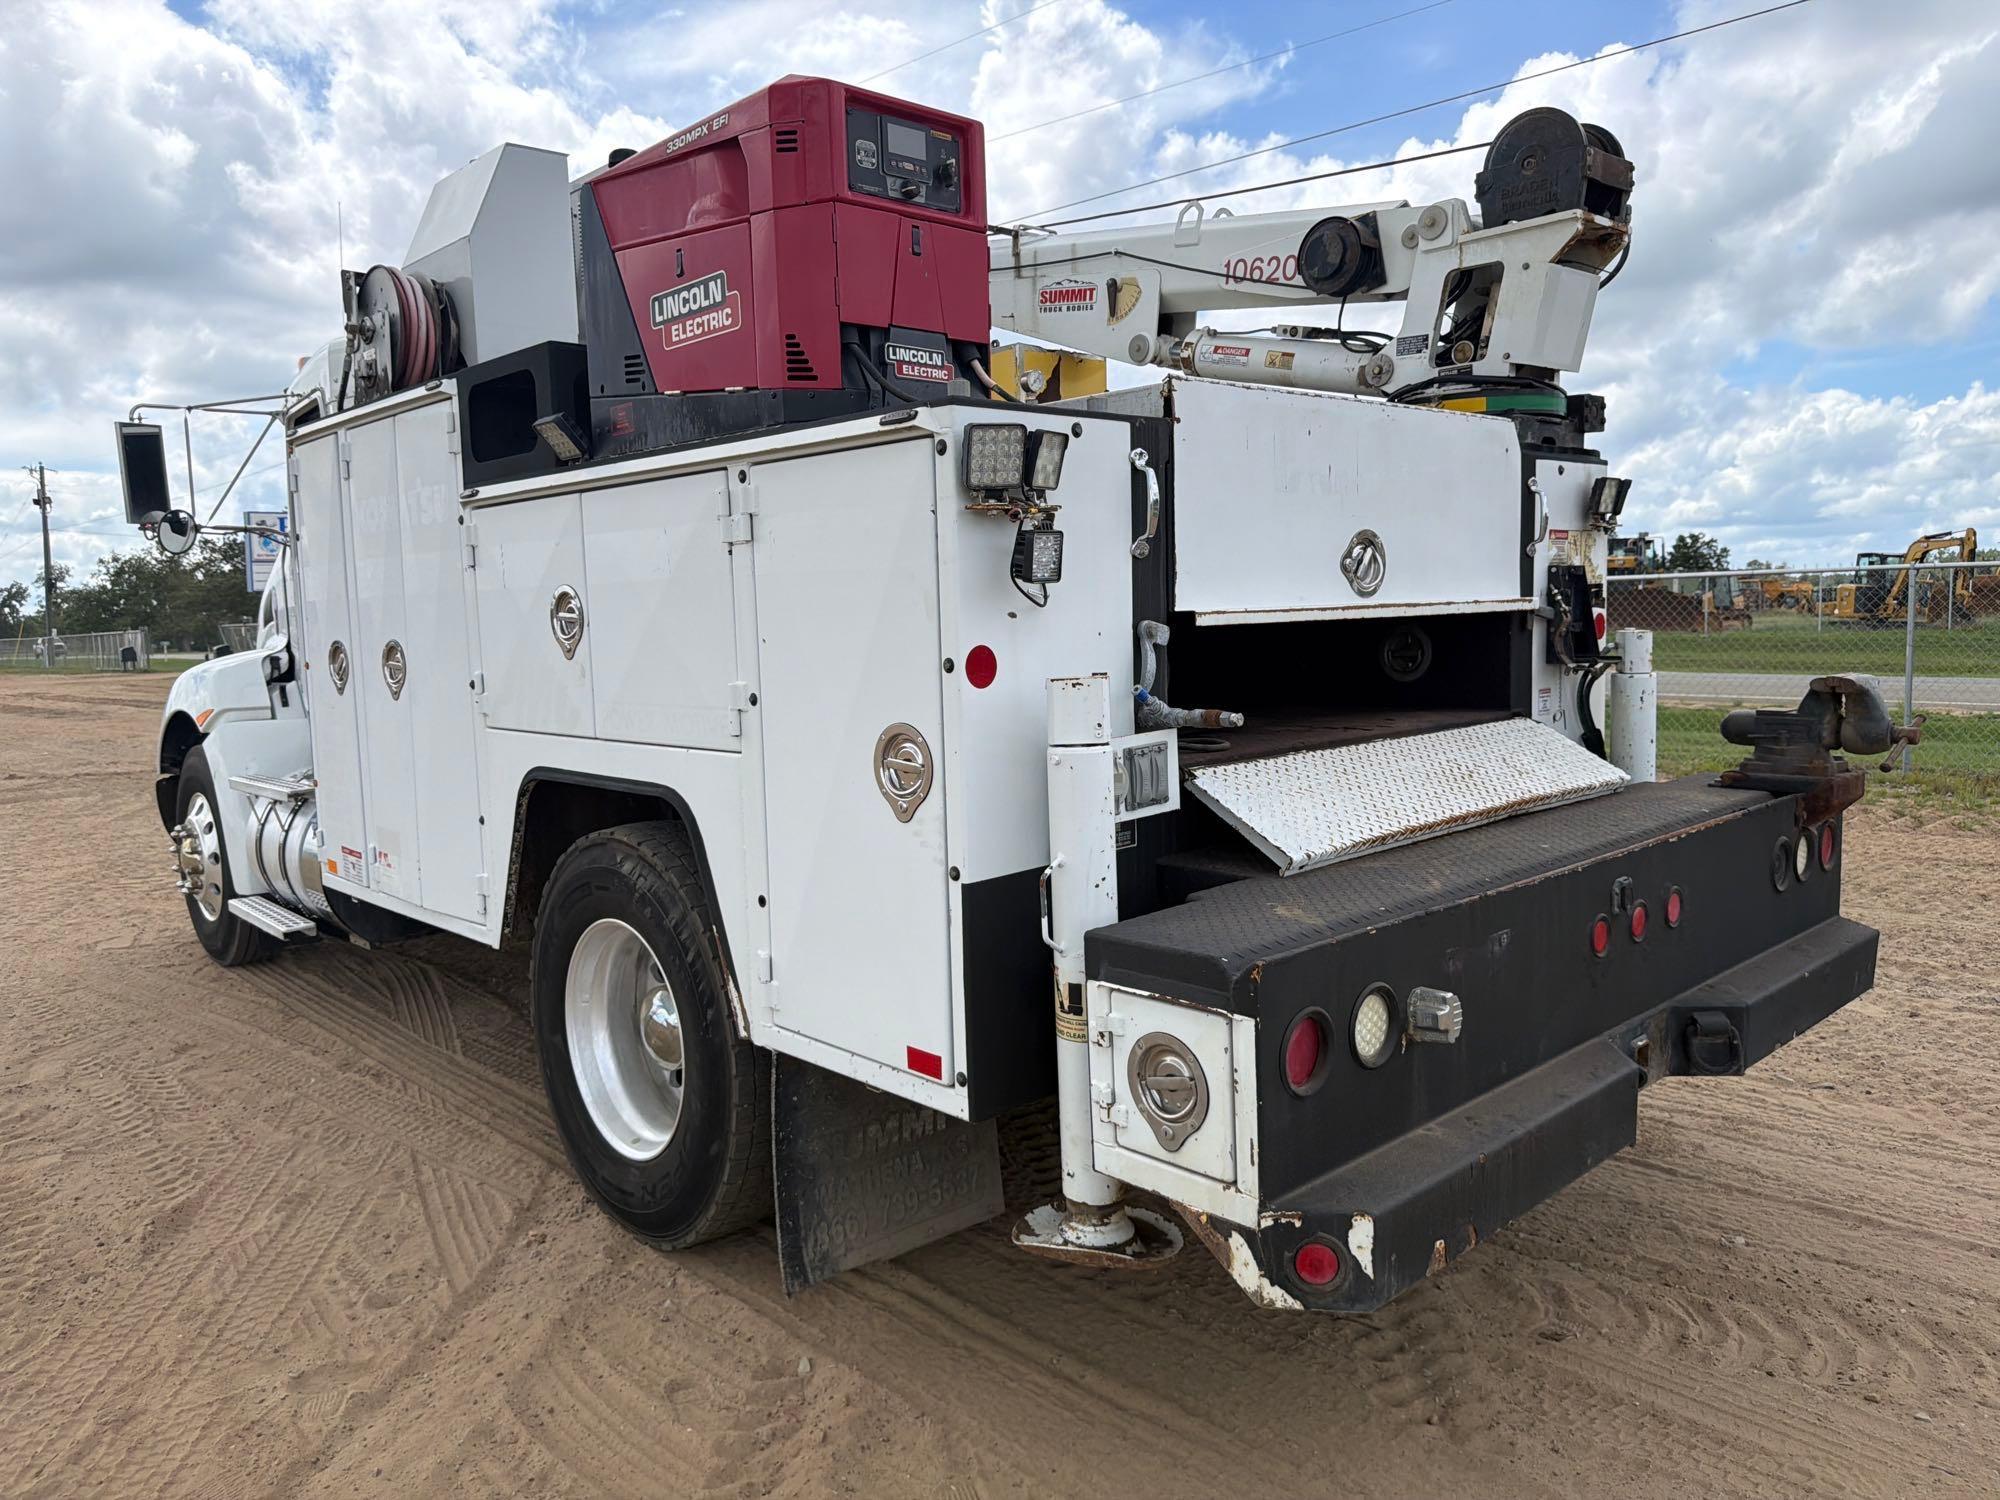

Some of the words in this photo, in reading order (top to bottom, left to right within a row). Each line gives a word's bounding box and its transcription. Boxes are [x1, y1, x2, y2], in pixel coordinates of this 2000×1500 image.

[666, 122, 709, 153] 330MPX
[713, 113, 729, 131] EFI
[1224, 254, 1298, 285] 10620
[655, 279, 722, 323] LINCOLN
[1040, 287, 1096, 305] SUMMIT
[1039, 305, 1063, 313] TRUCK
[1066, 304, 1094, 312] BODIES
[671, 307, 732, 342] ELECTRIC
[889, 346, 942, 366] LINCOLN
[1223, 347, 1247, 355] DANGER
[902, 365, 949, 379] ELECTRIC
[1066, 1031, 1087, 1040] CLEAR
